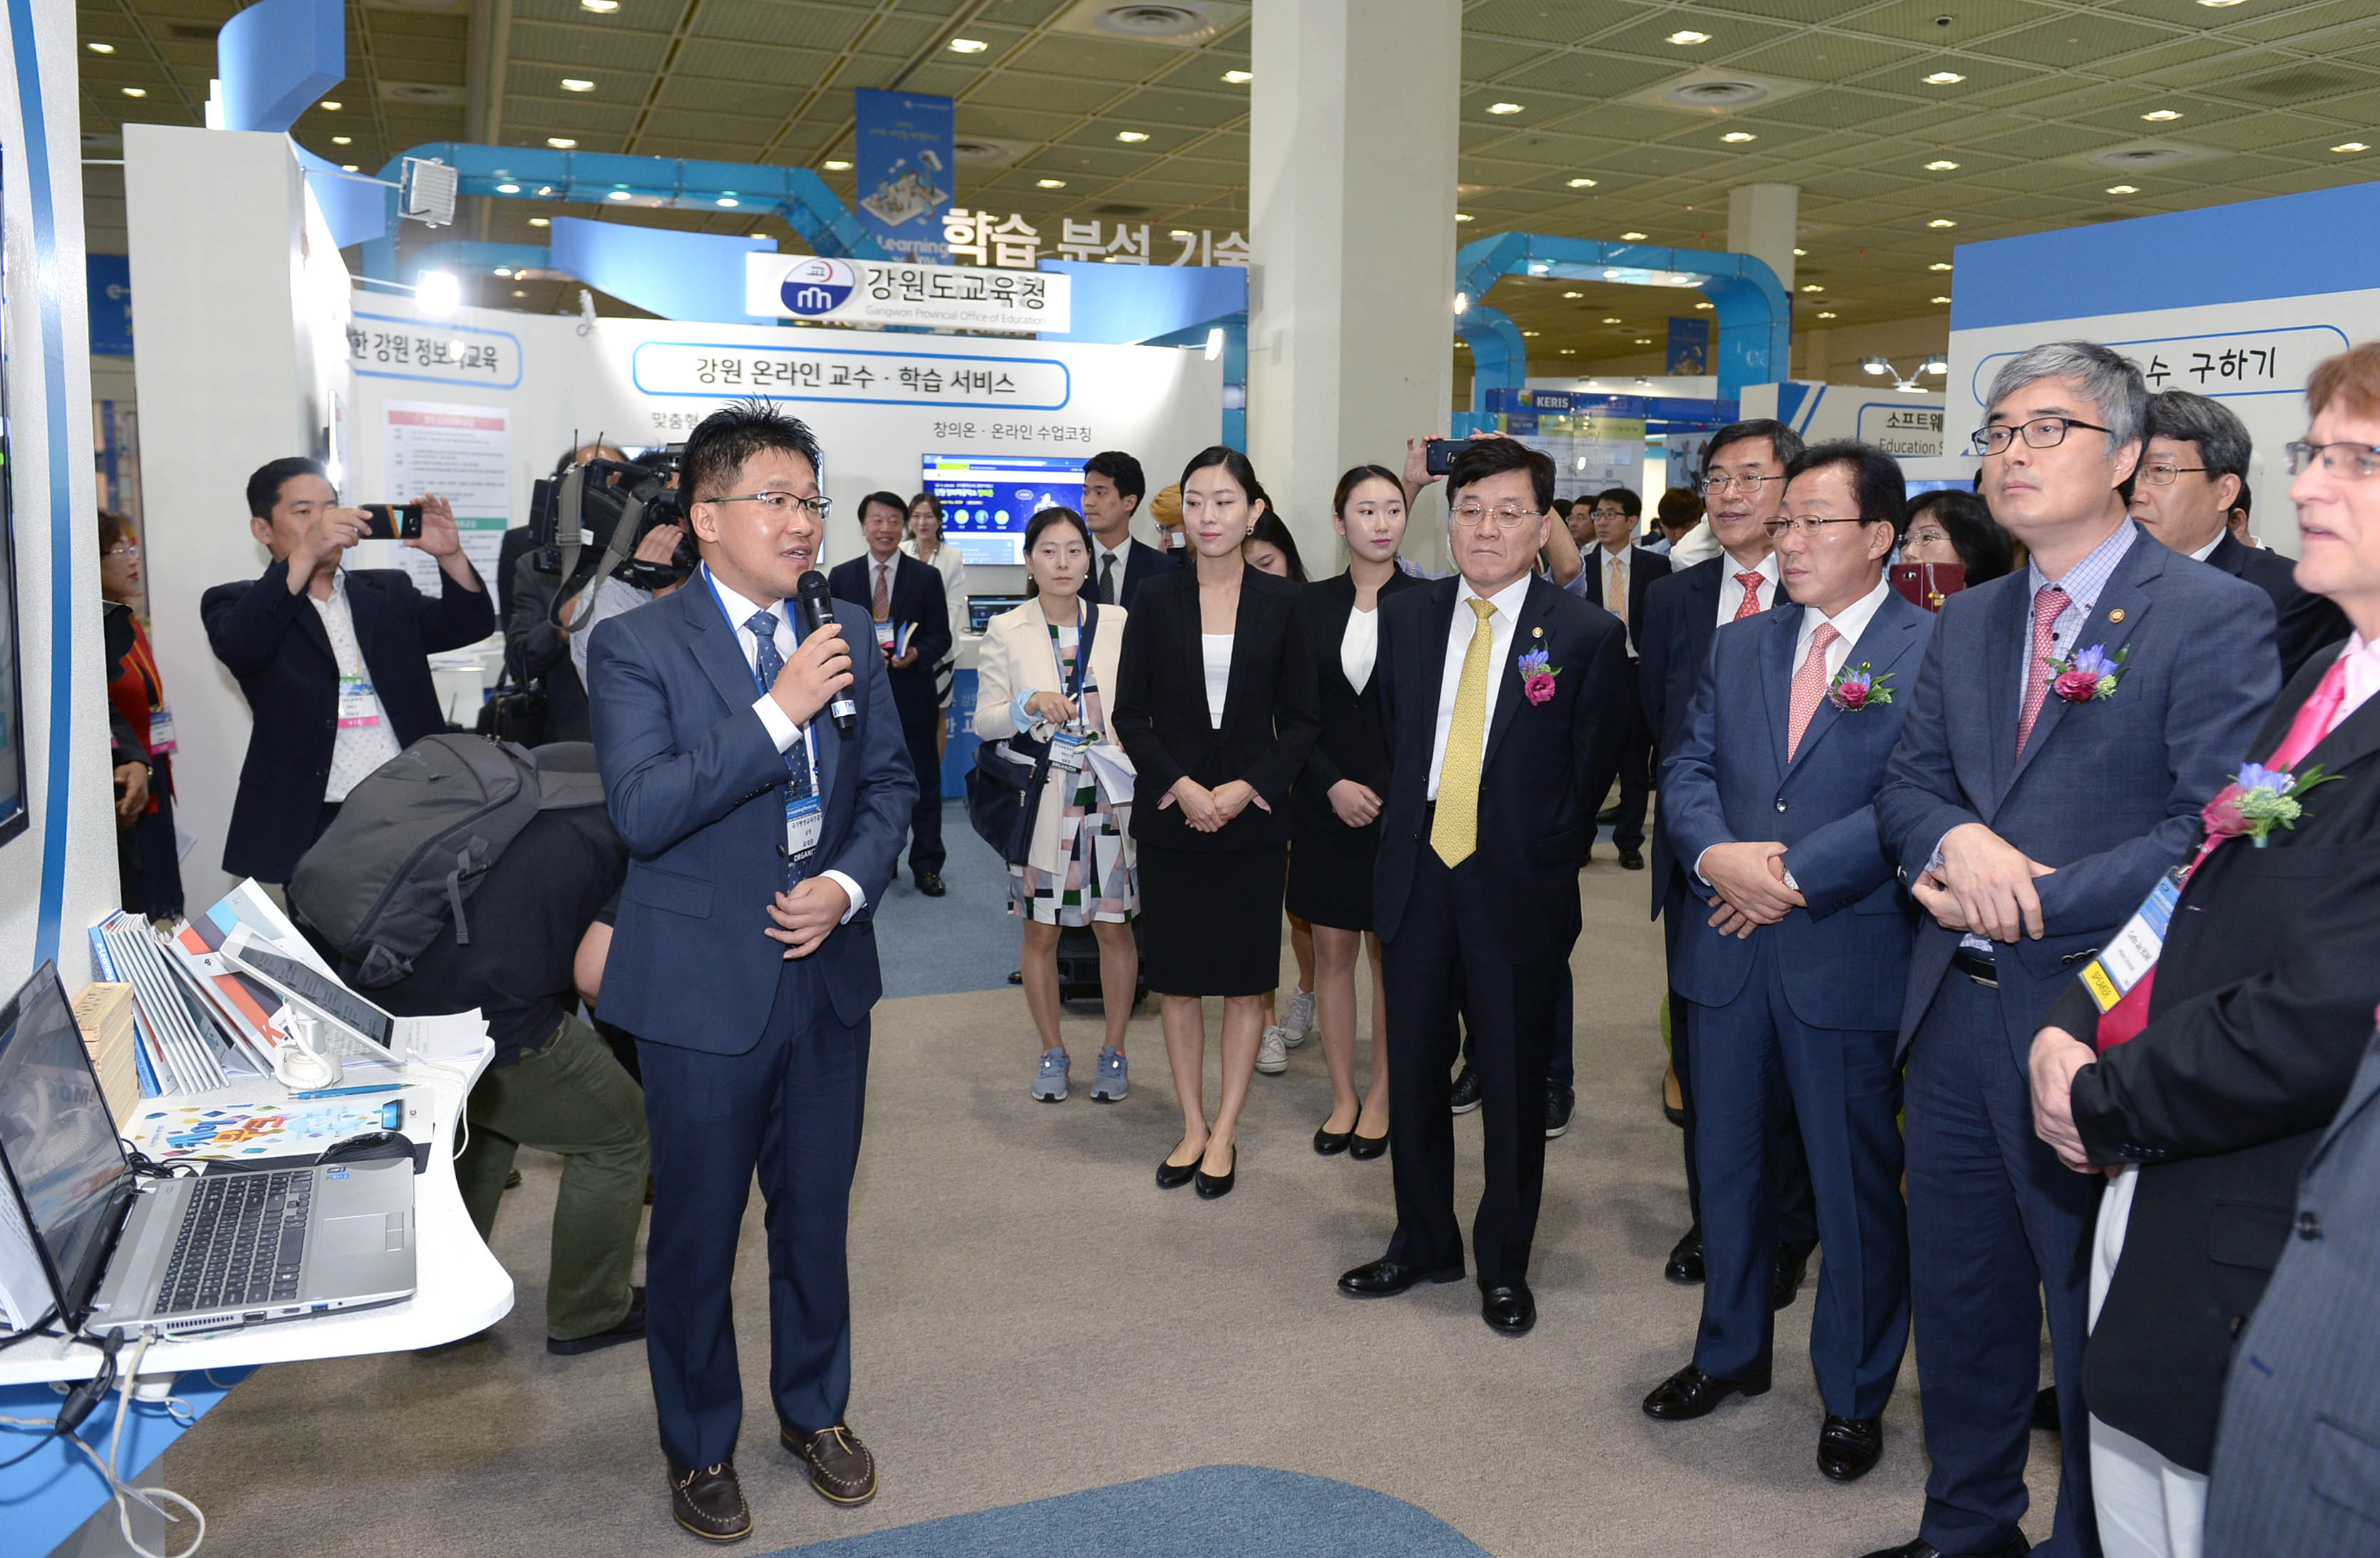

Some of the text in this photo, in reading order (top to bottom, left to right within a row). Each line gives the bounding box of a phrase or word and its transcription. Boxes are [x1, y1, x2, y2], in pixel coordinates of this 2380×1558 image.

[942, 208, 1041, 267] 학습
[867, 268, 1046, 310] 강원도교육청
[866, 306, 1047, 325] Gangwon Provincial Office of Education
[373, 333, 409, 364] 강원
[696, 358, 742, 385] 강원
[750, 360, 821, 388] 온라인
[828, 365, 875, 389] 교수
[898, 366, 943, 393] 학습
[950, 369, 1017, 395] 서비스
[2189, 345, 2276, 385] 구하기
[1536, 396, 1569, 408] KERIS
[933, 421, 977, 439] 창의온
[990, 423, 1034, 441] 온라인
[1037, 425, 1092, 442] 수업코칭
[1879, 437, 1936, 455] Education
[96, 942, 115, 981] e-Learning
[2092, 970, 2112, 998] SPEAKER
